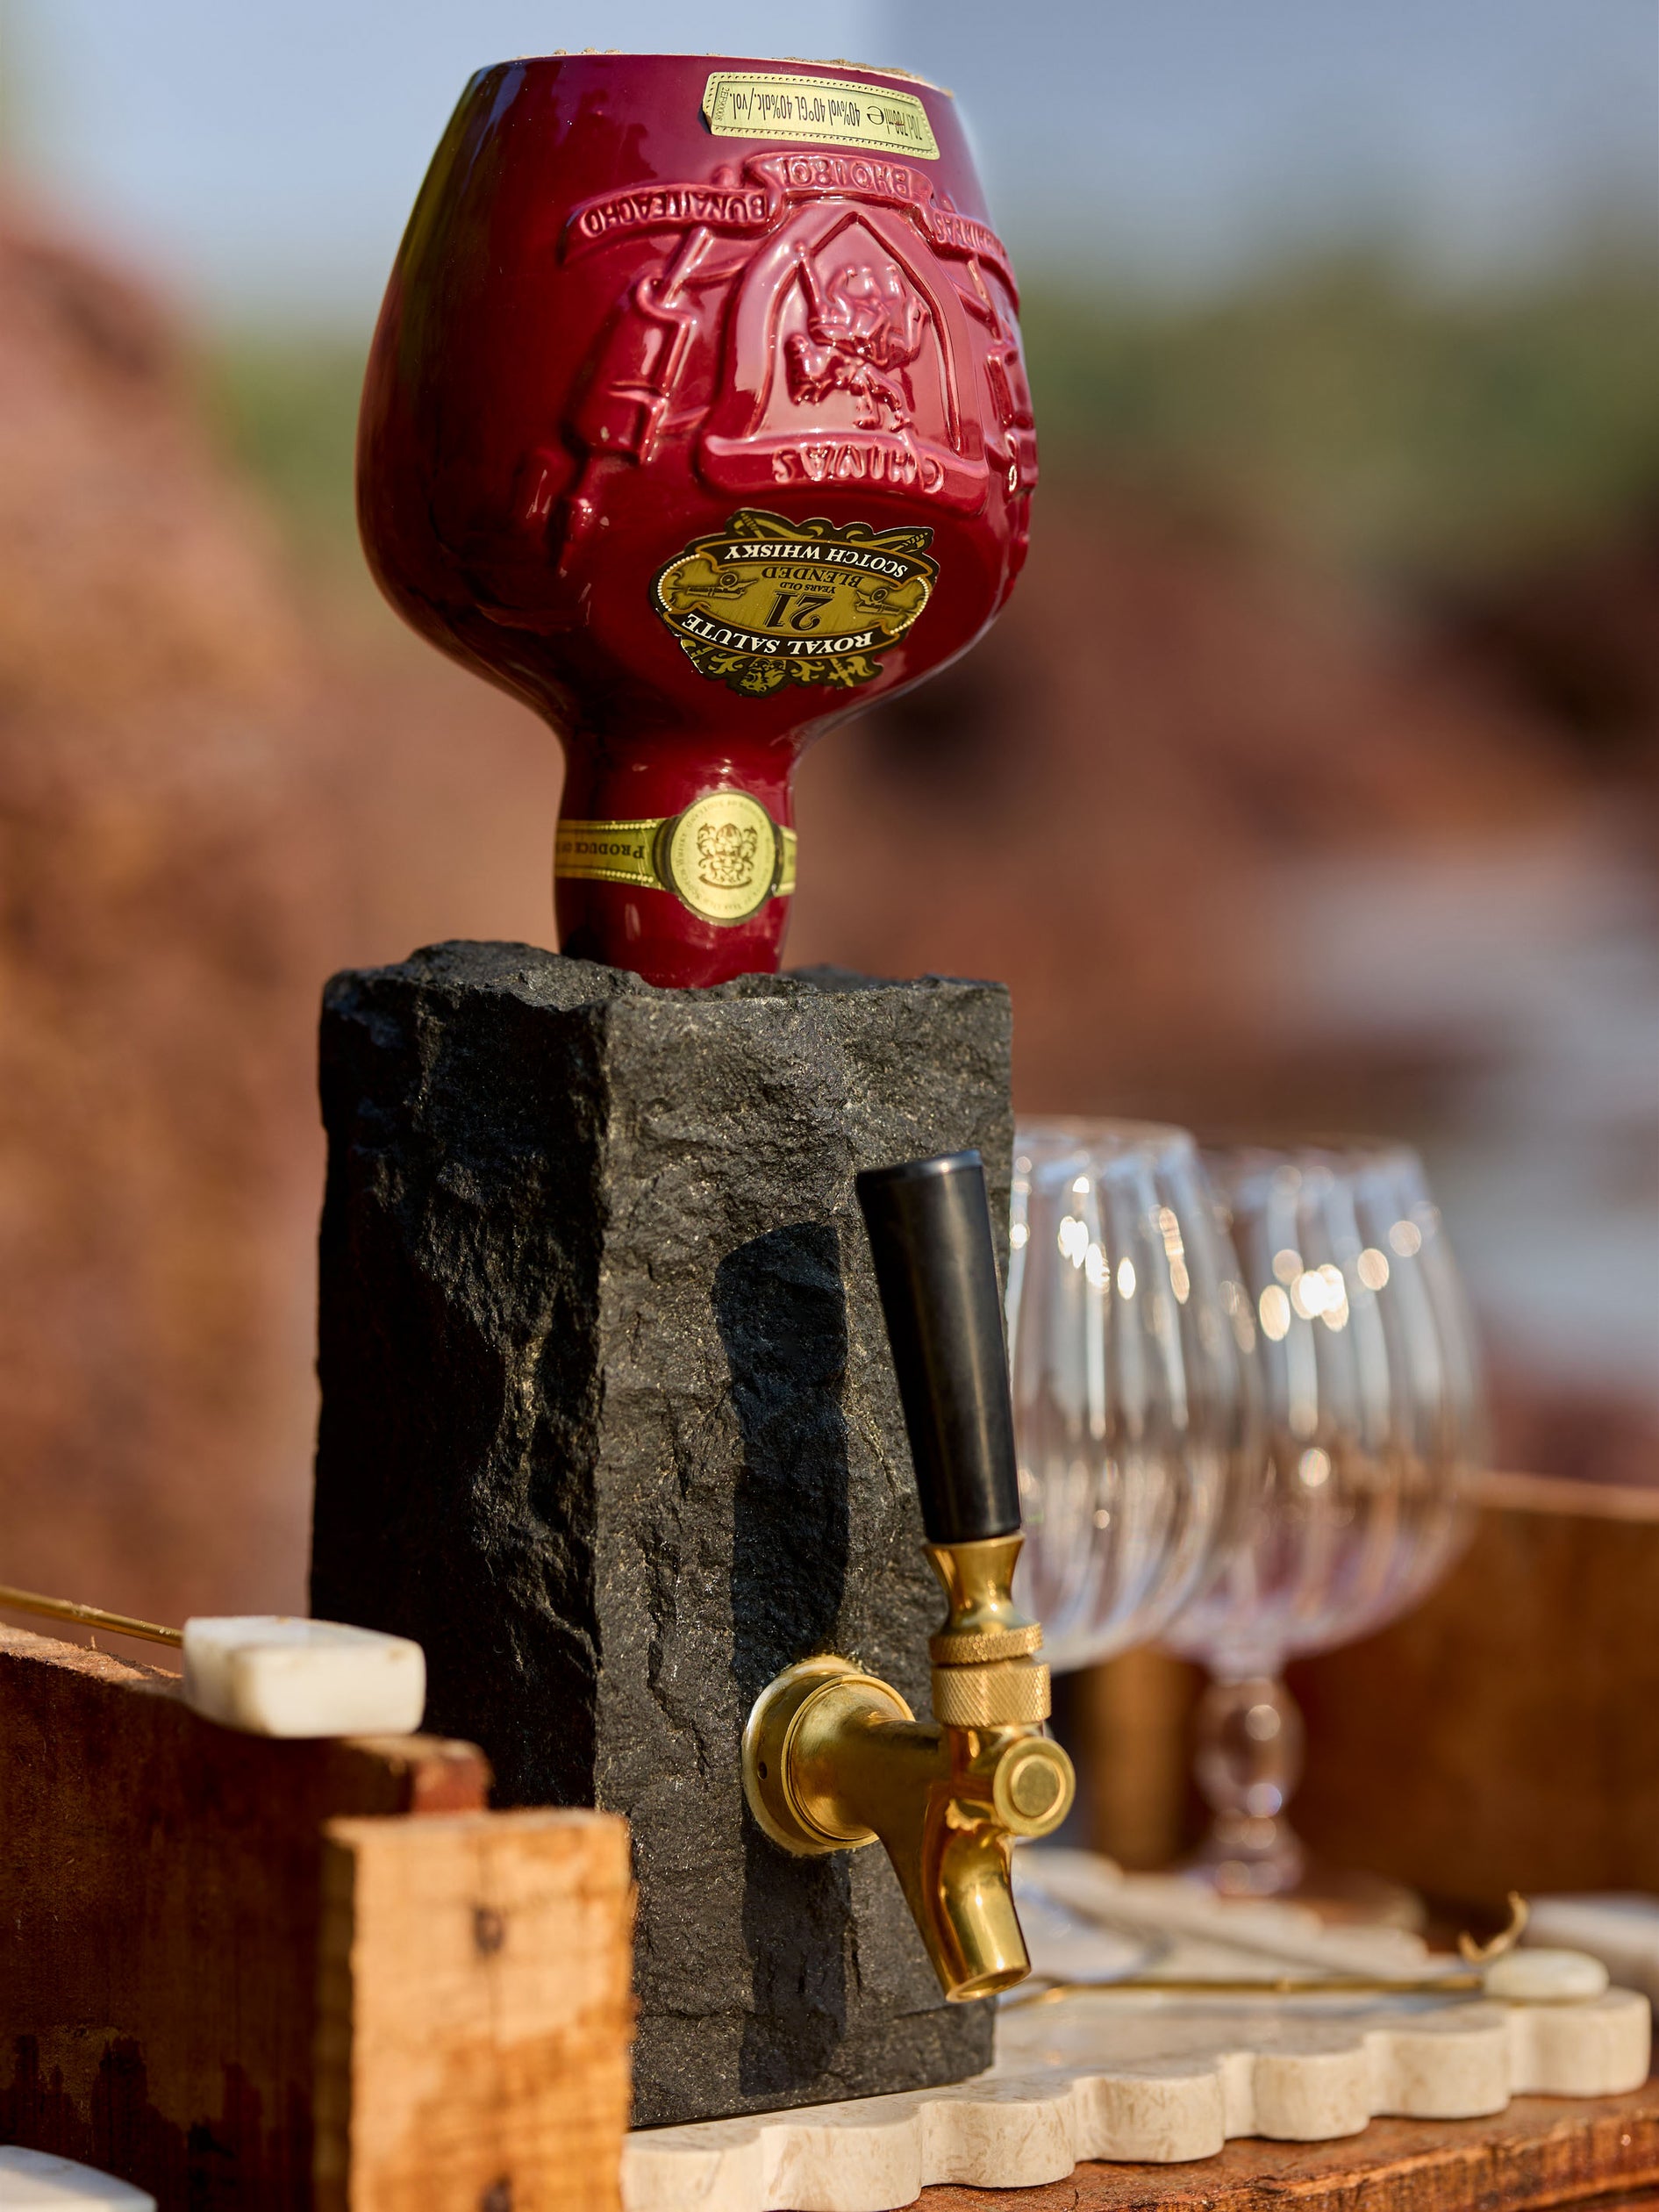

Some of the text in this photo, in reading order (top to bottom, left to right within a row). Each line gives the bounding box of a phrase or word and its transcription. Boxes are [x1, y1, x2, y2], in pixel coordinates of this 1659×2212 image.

[795, 97, 826, 122] 40°GL
[829, 99, 861, 127] 40%vol
[772, 444, 945, 494] CHIVAS
[724, 544, 909, 578] SCOTCH WHISKY
[762, 566, 864, 589] BLENDED
[779, 581, 838, 594] YEARS OLD
[763, 591, 835, 632] 21
[682, 613, 874, 655] ROYAL SALUTE
